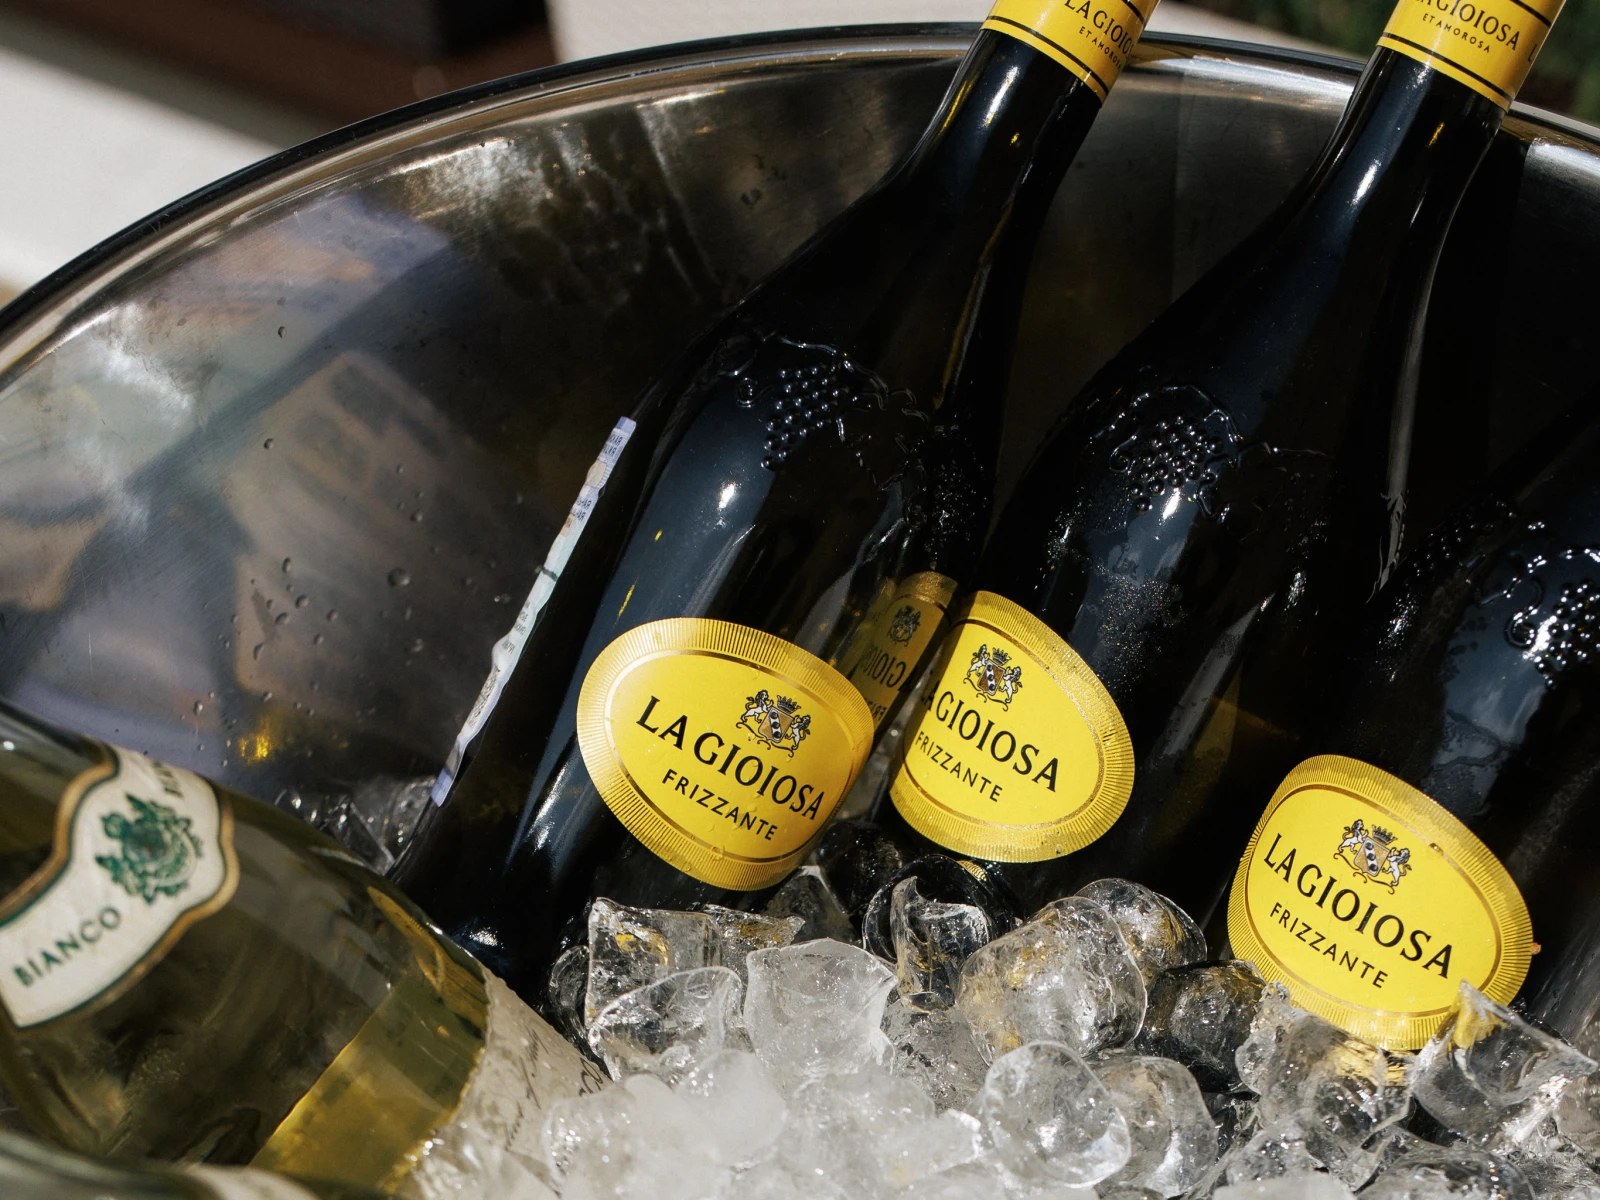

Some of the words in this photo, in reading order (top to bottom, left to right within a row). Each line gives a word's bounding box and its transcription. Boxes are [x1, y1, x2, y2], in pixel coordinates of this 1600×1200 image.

[1093, 10, 1134, 55] GIOIO
[915, 730, 1003, 803] FRIZZANTE
[661, 768, 779, 841] FRIZZANTE
[13, 906, 122, 988] BIANCO
[1269, 901, 1389, 989] FRIZZANTE
